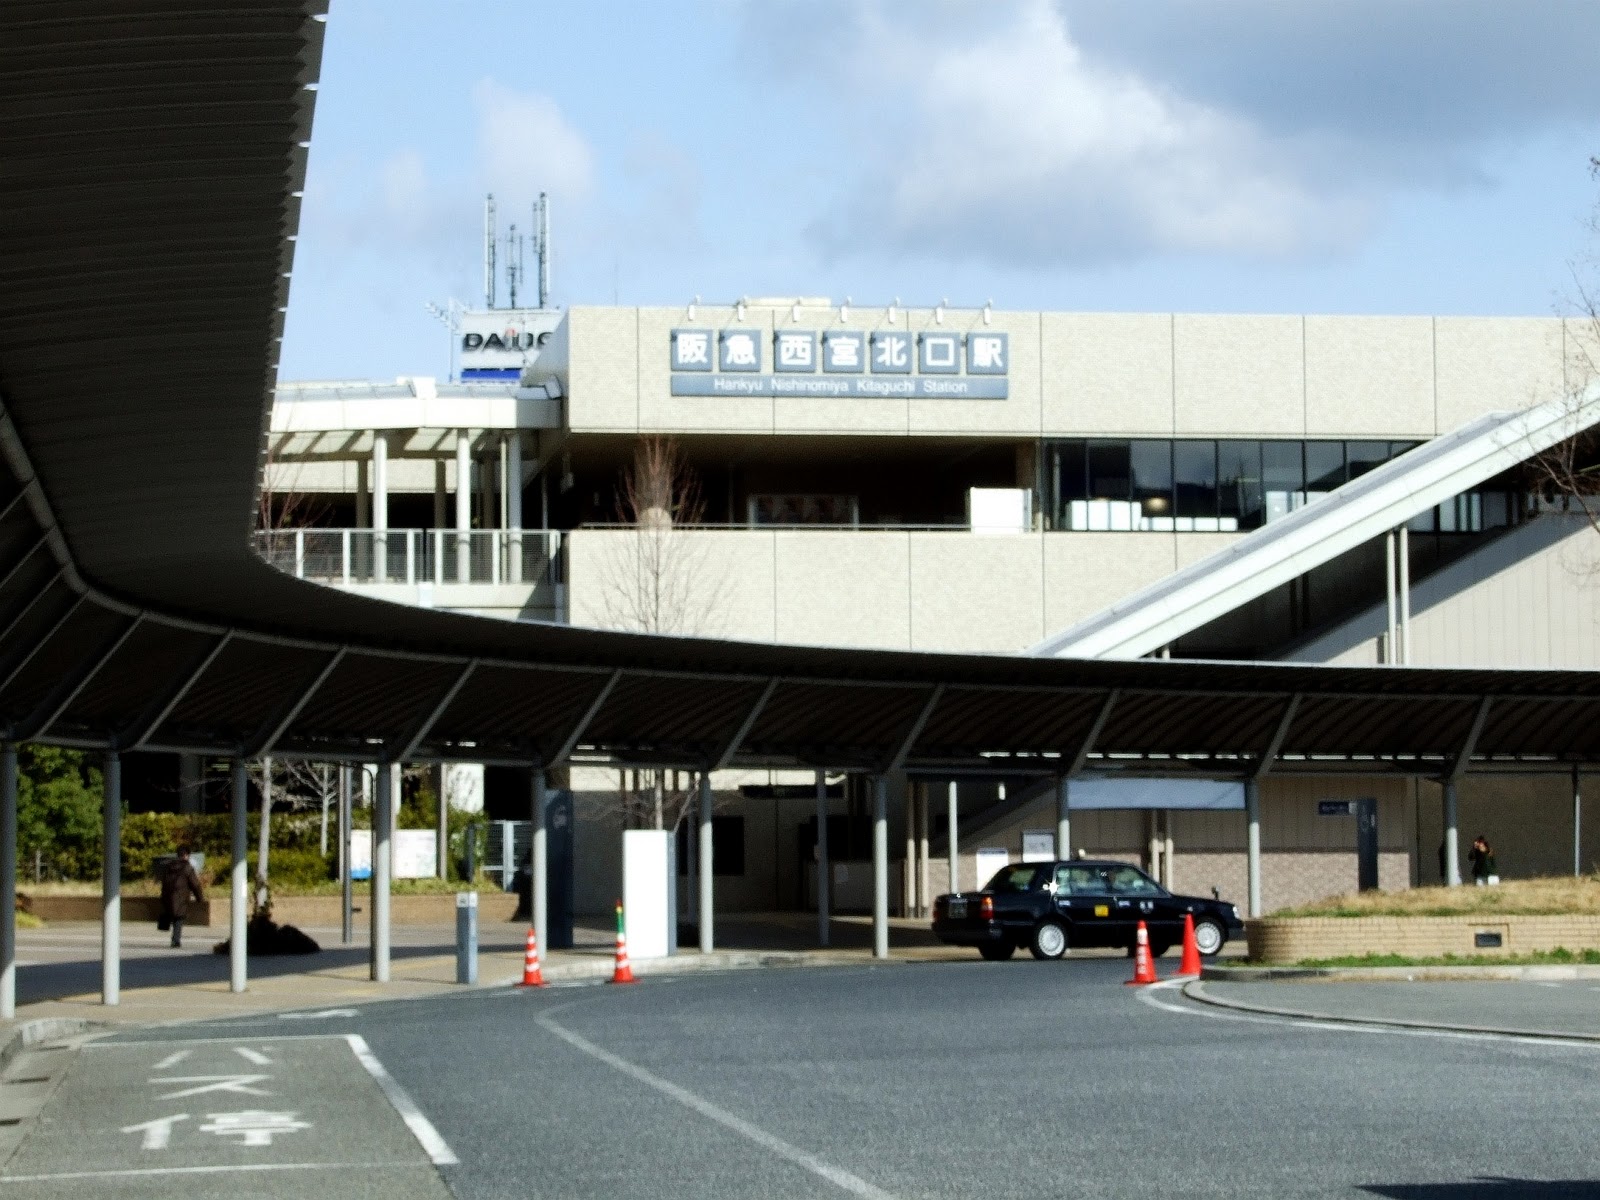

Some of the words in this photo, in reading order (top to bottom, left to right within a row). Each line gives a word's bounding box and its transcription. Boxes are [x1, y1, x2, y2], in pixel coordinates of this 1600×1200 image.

[677, 333, 1003, 367] 阪急西宮北口駅
[714, 378, 763, 394] Hankyu
[771, 379, 849, 395] Nishinomiya
[857, 380, 915, 396] Kitaguchi
[923, 381, 968, 393] Station
